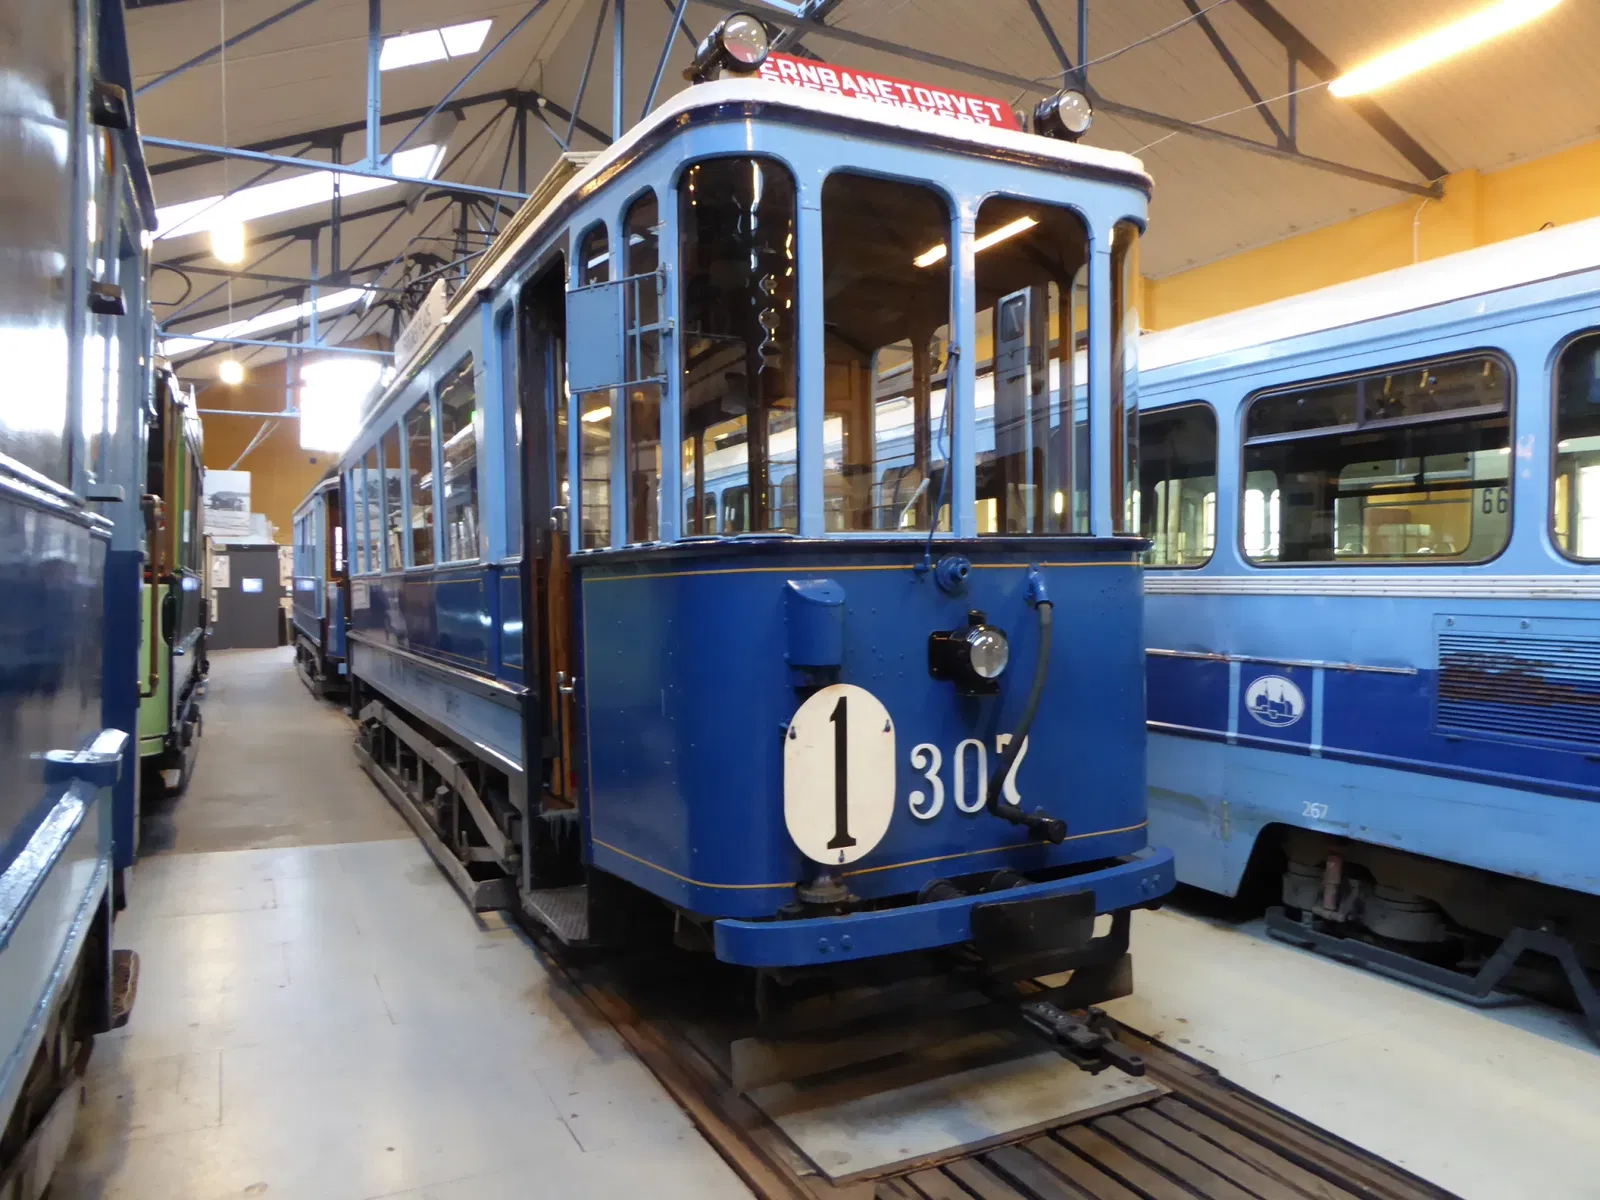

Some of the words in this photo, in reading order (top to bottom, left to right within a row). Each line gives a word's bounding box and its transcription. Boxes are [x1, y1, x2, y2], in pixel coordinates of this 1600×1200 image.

[827, 696, 856, 849] 1
[909, 733, 1029, 819] 307
[1302, 801, 1328, 819] 267
